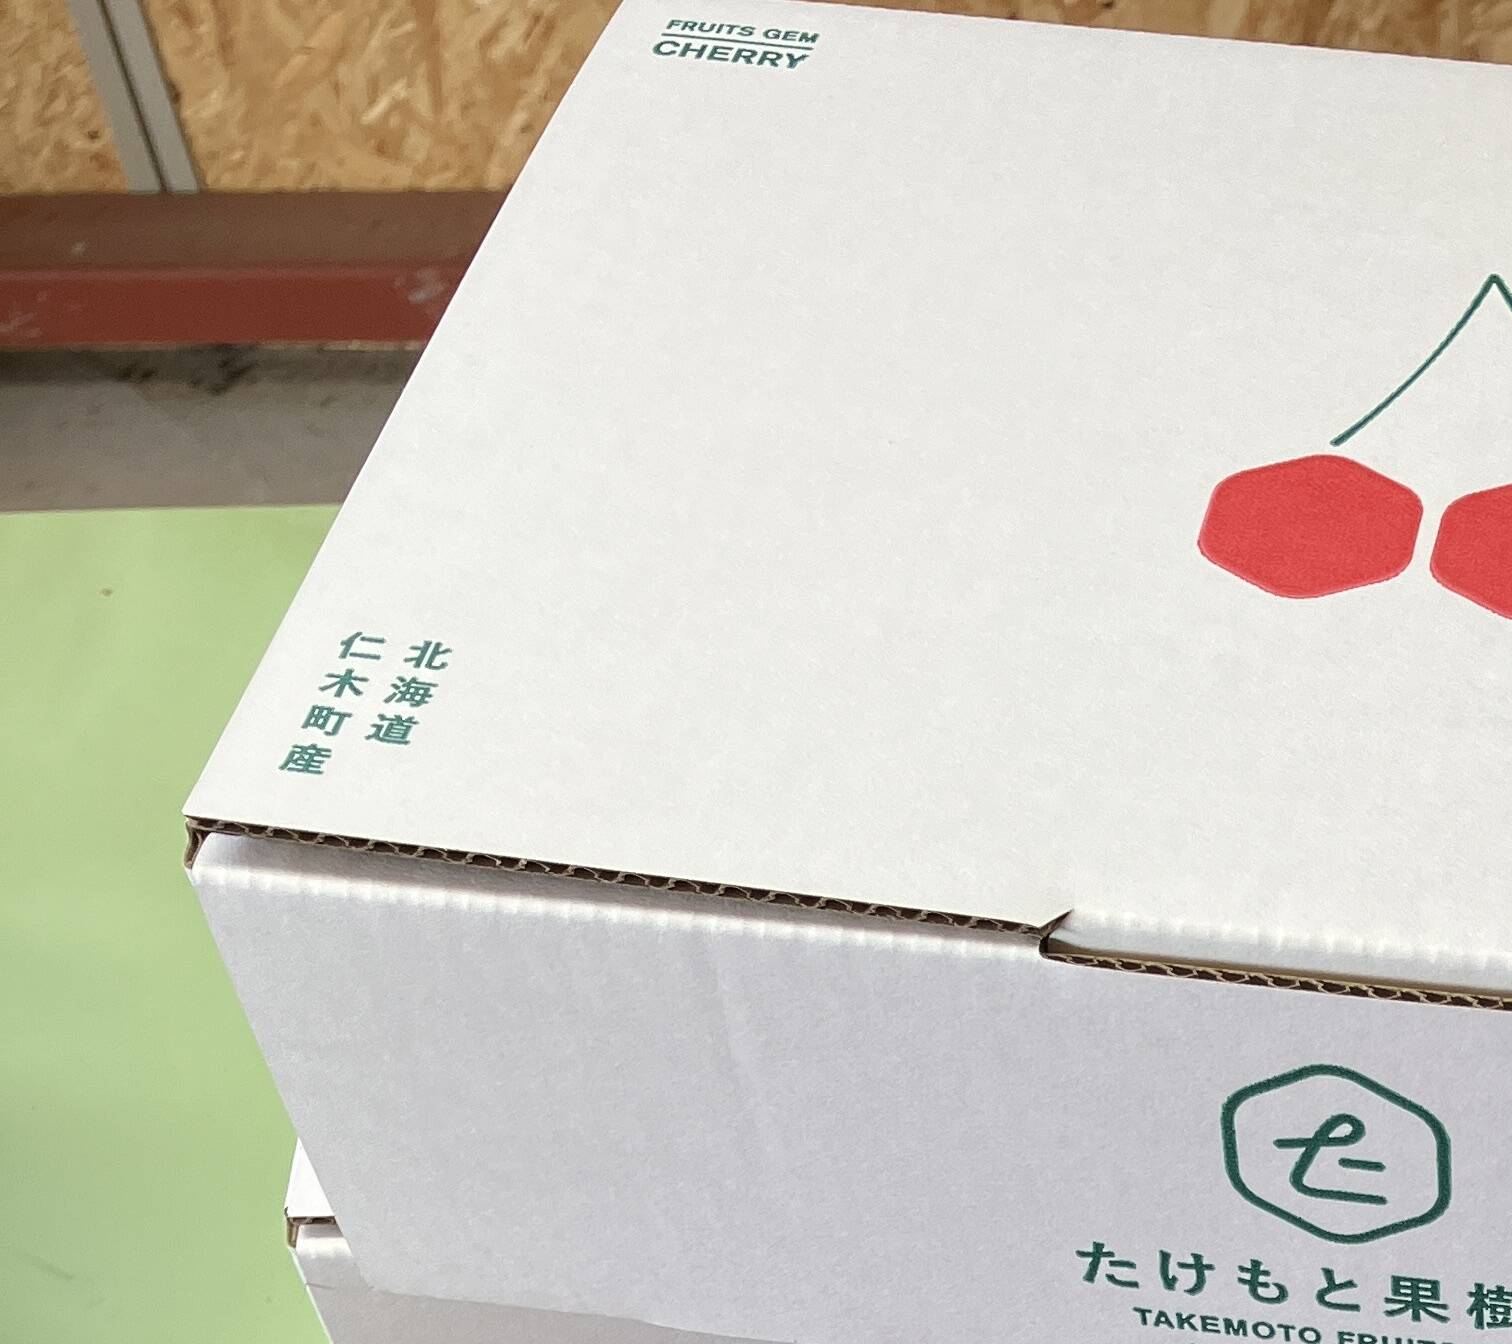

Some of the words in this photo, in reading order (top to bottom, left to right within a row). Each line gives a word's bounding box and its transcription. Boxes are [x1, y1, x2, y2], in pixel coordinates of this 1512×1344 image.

[667, 20, 755, 36] FRUITS
[763, 29, 819, 43] GEM
[653, 41, 808, 68] CHERRY
[279, 632, 384, 774] 仁木町産
[366, 641, 452, 745] 北海道
[1133, 1307, 1321, 1344] TAKEMOTO
